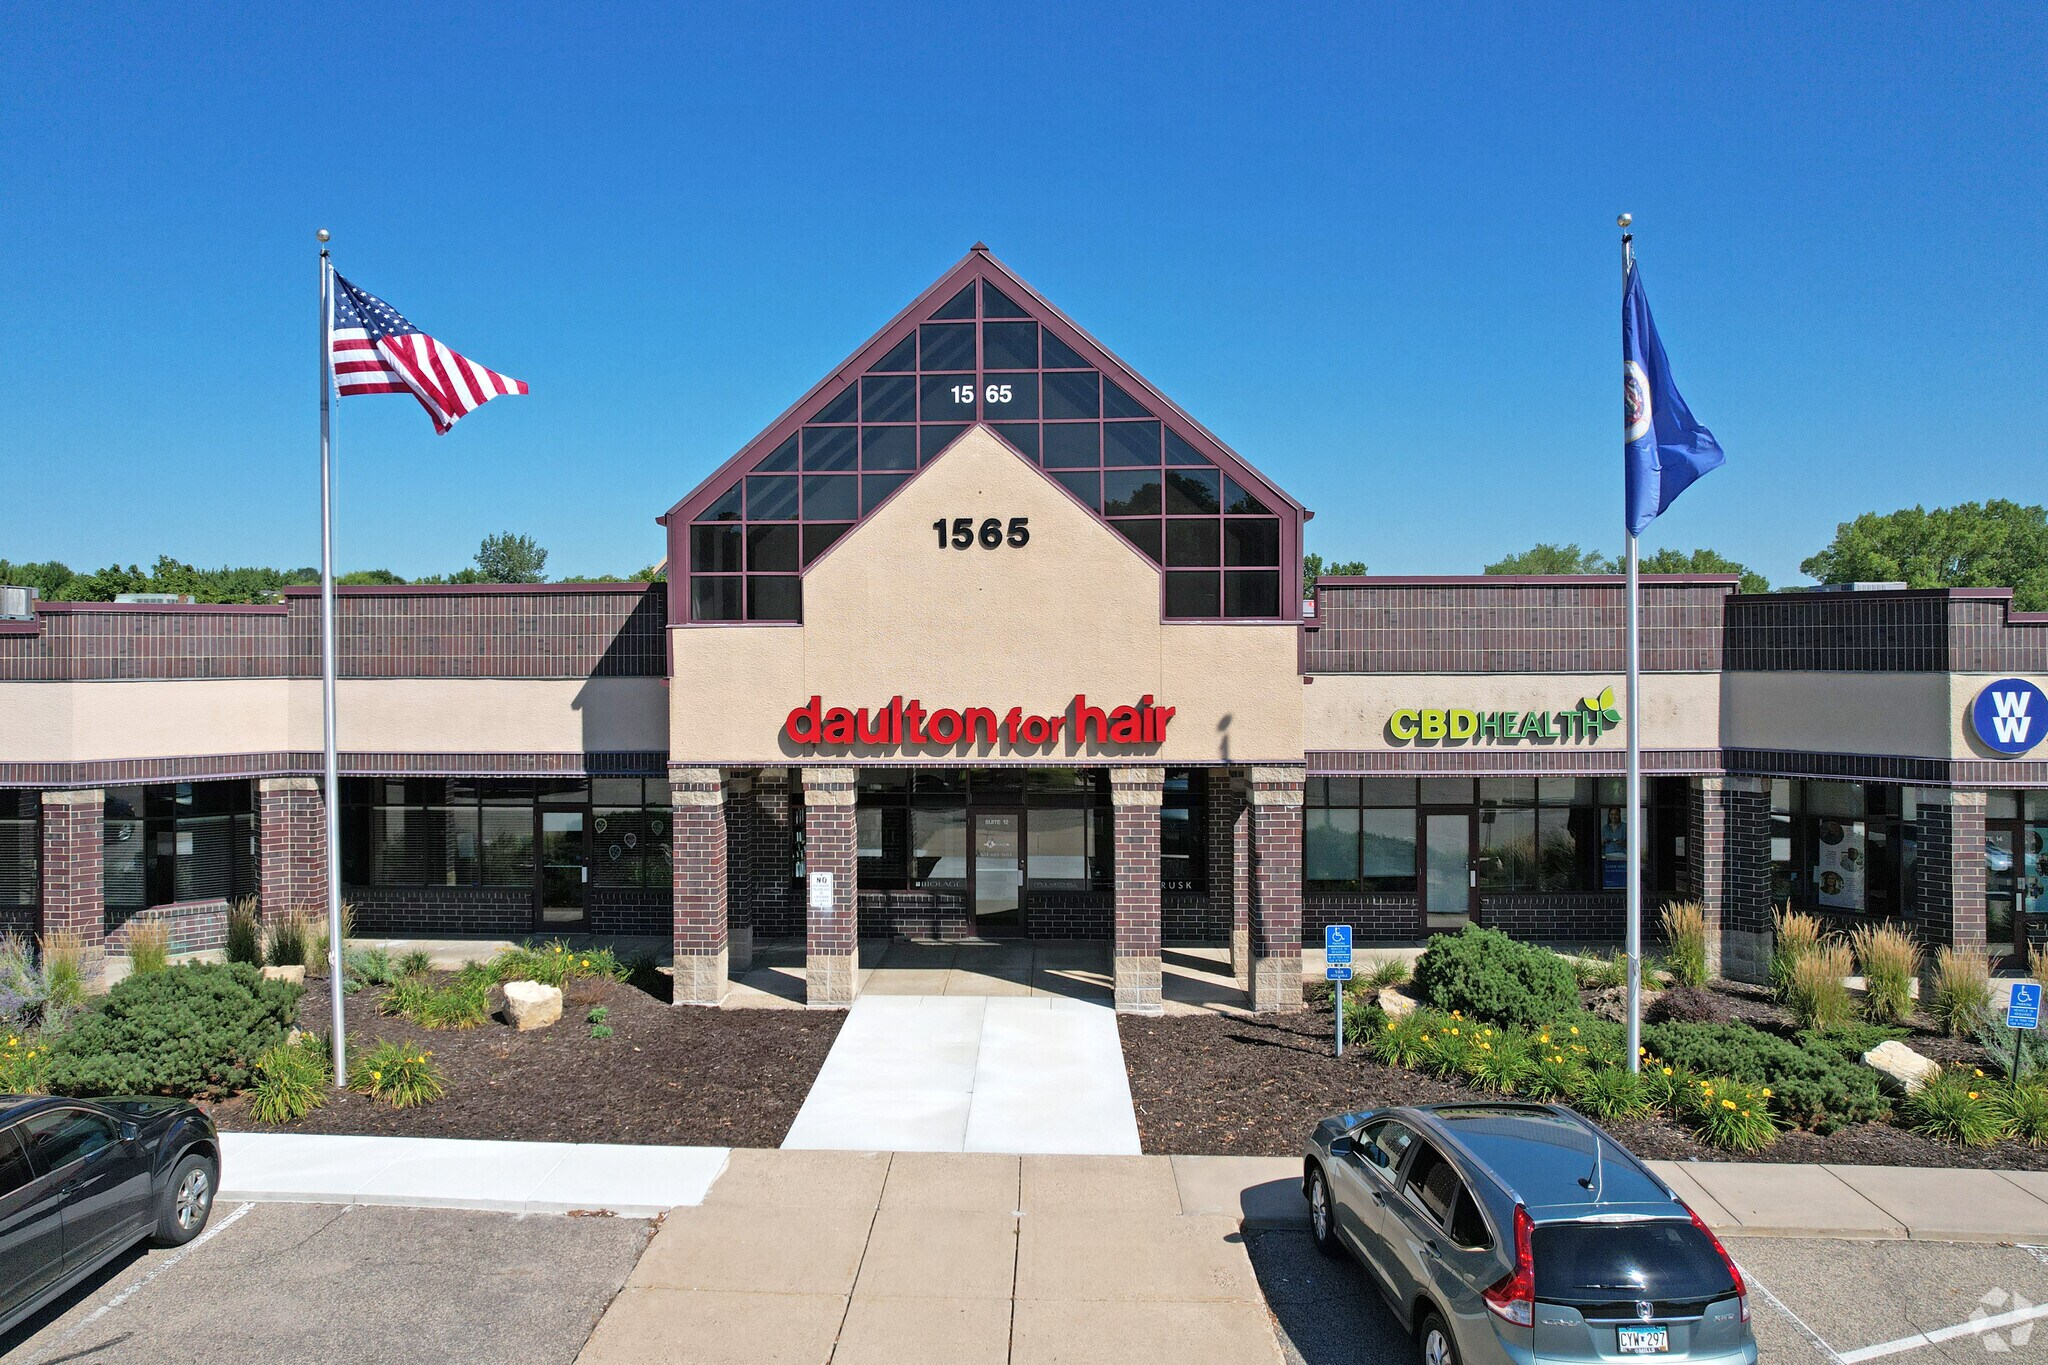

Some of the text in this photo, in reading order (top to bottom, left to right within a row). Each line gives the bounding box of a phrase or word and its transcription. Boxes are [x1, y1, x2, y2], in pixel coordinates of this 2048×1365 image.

[932, 517, 1031, 551] 1565
[785, 694, 1176, 745] daulton for hair
[1161, 880, 1192, 890] RUSK
[1646, 1332, 1665, 1347] 297
